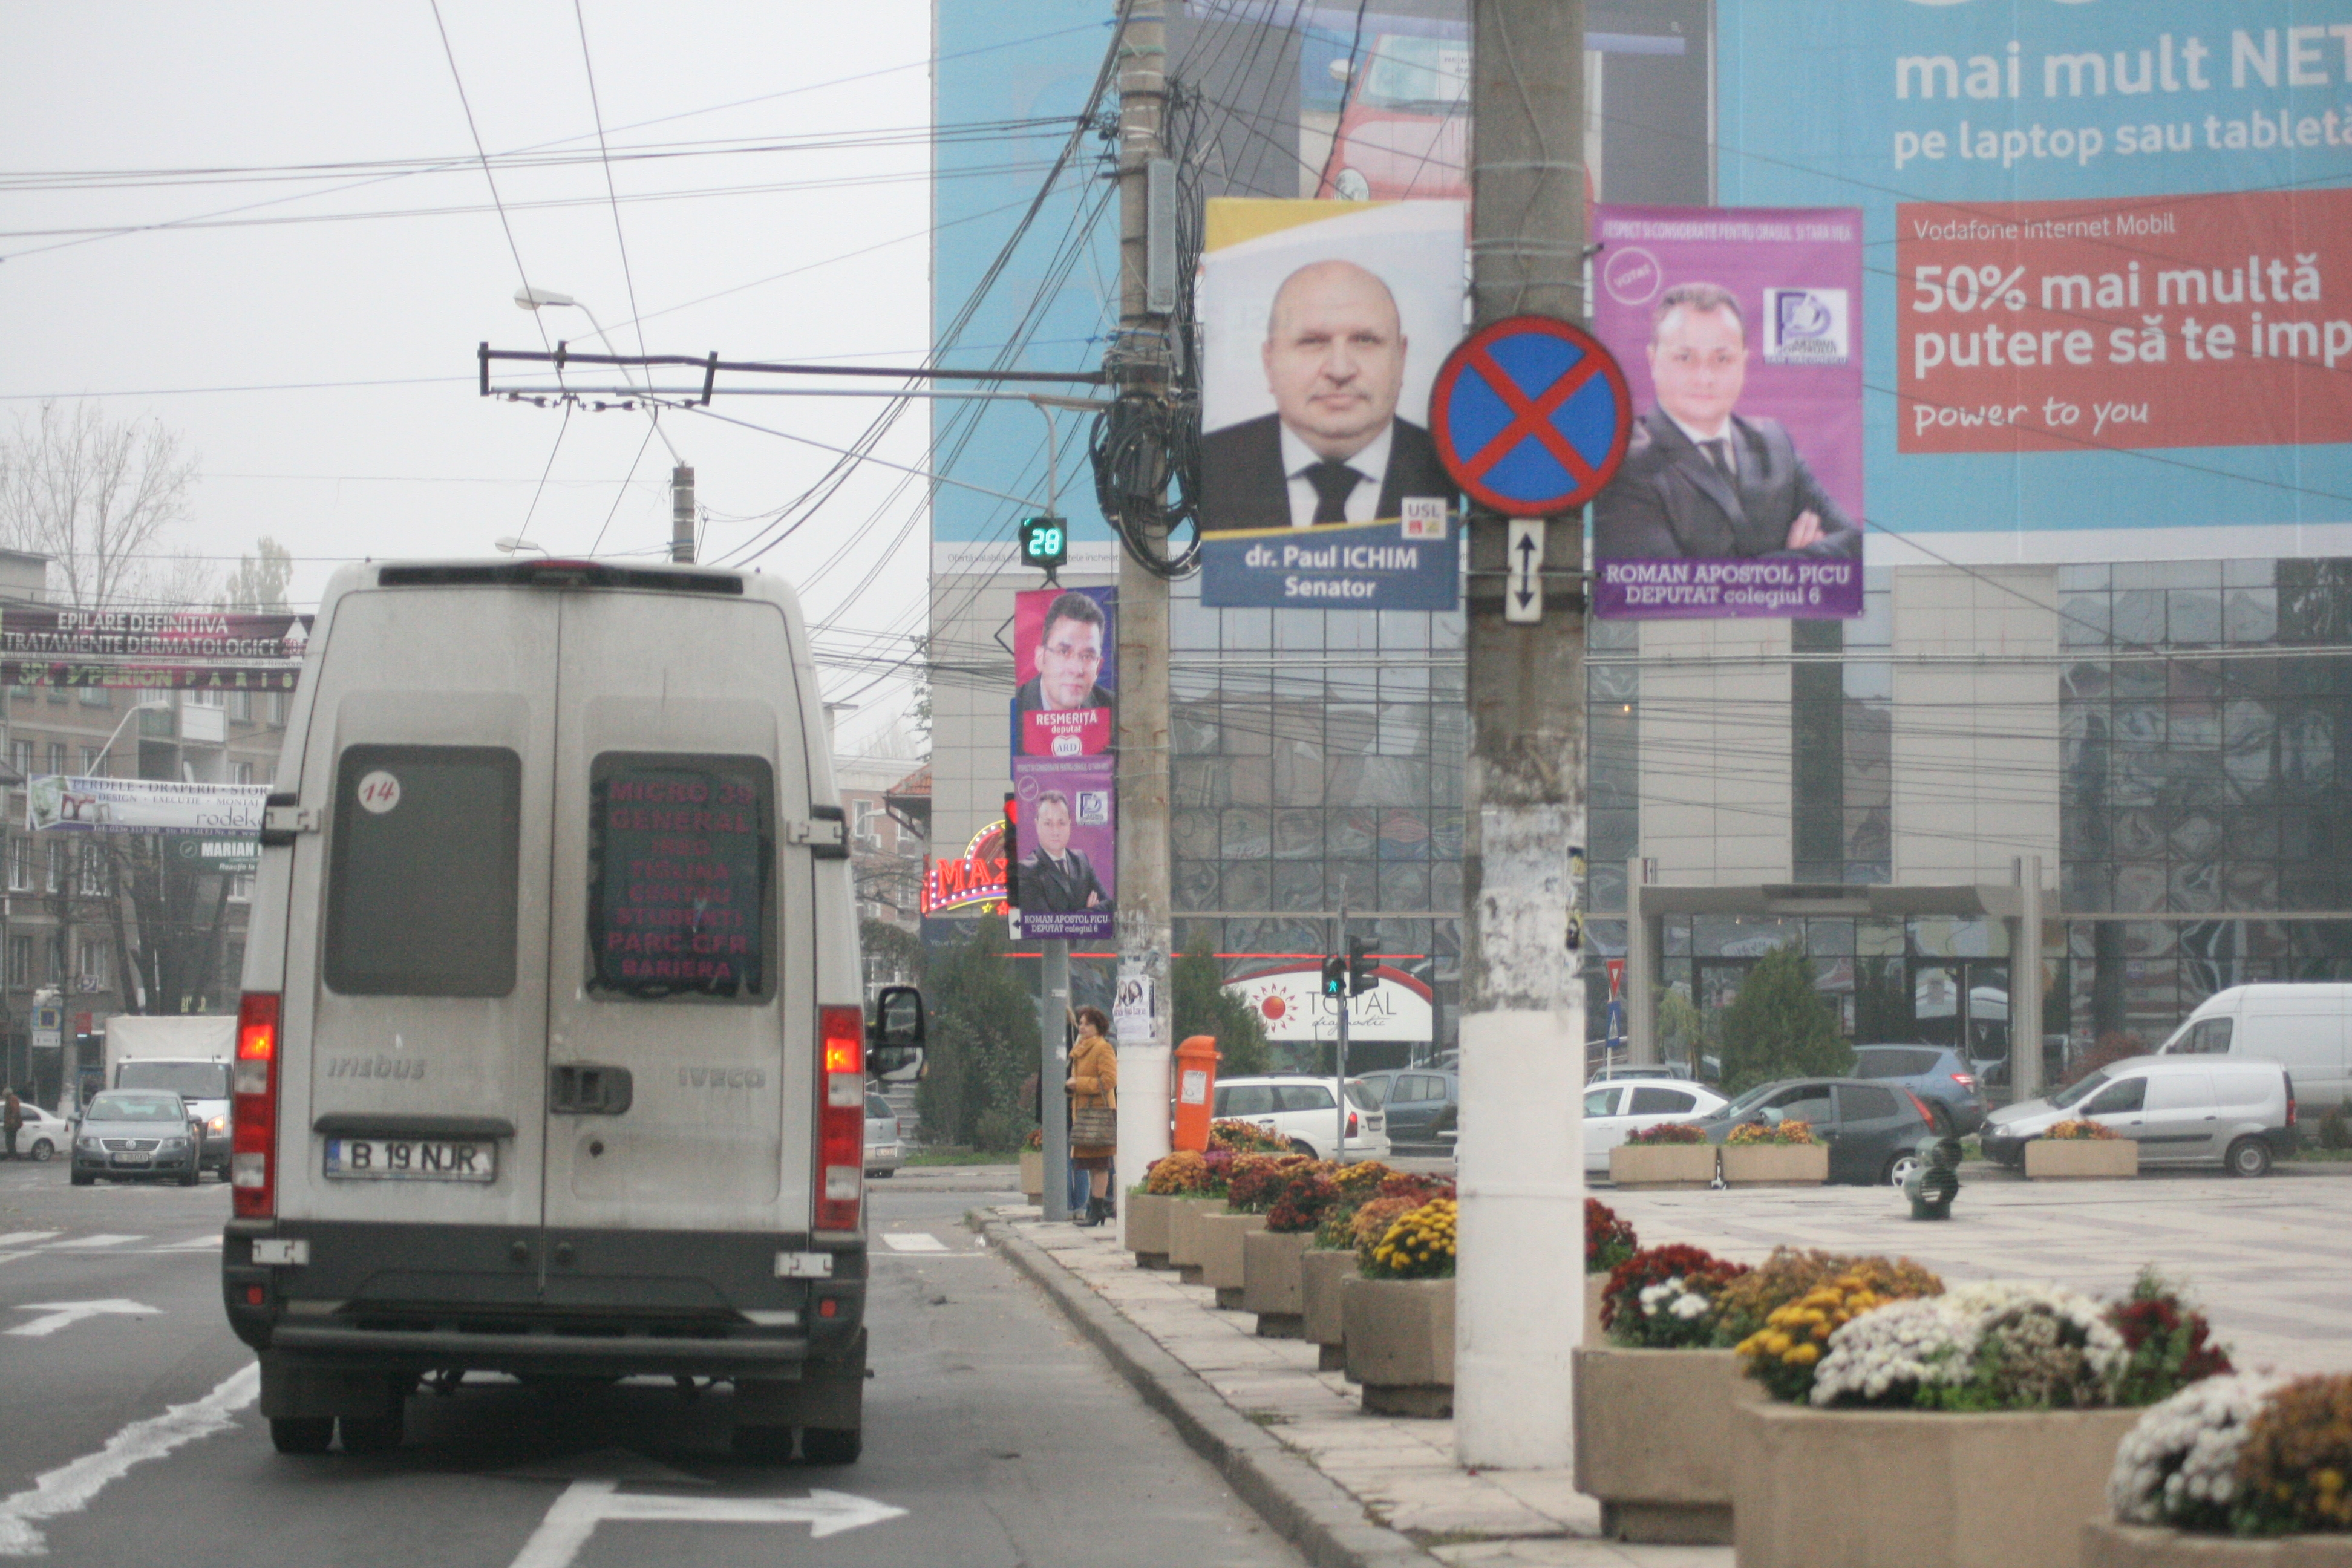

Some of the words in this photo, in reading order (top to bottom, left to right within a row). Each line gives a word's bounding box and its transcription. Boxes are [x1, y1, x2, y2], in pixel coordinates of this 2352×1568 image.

[1895, 39, 2020, 99] mai
[2043, 33, 2210, 98] mult
[1894, 130, 1947, 170] pe
[1959, 121, 2103, 169] laptop
[2115, 123, 2192, 155] sau
[1913, 218, 2019, 241] Vodafone
[2116, 212, 2176, 235] Mobil
[1912, 264, 2027, 312] 50%
[2041, 260, 2140, 310] mai
[2157, 252, 2321, 307] multă
[1914, 323, 2094, 379] putere
[2108, 313, 2167, 364] să
[2181, 317, 2236, 361] te
[1912, 402, 2028, 436] power
[2042, 396, 2080, 426] to
[2092, 402, 2149, 436] you
[1408, 503, 1437, 517] USL
[1029, 528, 1060, 555] 28
[1244, 544, 1278, 567] dr.
[1283, 544, 1336, 568] Paul
[1343, 546, 1418, 570] ICHIM
[1605, 564, 1689, 583] ROMAN
[1694, 564, 1794, 584] APOSTOL
[1798, 564, 1851, 584] PICU
[1284, 575, 1376, 598] Senator
[1625, 585, 1720, 604] DEPUTAT
[1723, 586, 1805, 608] colegiul
[1808, 586, 1821, 604] 6
[57, 612, 126, 632] EPILARE
[129, 613, 229, 635] DEFINITIVA
[4, 631, 124, 653] TRATAMENTE
[127, 635, 279, 656] DERMATOLOGICE
[1051, 724, 1082, 734] deputat
[1057, 743, 1077, 753] ARD
[73, 779, 135, 791] PERDELE
[149, 782, 215, 794] DRAPERII
[363, 782, 394, 802] 14
[610, 782, 710, 803] MICRO
[98, 794, 137, 802] DESIGN
[153, 796, 200, 805] EXECUTIE
[217, 797, 258, 807] MONTAJ
[610, 809, 753, 834] GENERAL
[201, 842, 255, 857] MARIAN
[629, 884, 732, 903] CENTRU
[1024, 915, 1053, 924] ROMAN
[1054, 915, 1089, 924] APOSTOL
[1090, 914, 1108, 924] PICU
[1031, 924, 1064, 933] DEPUTAT
[1065, 923, 1092, 935] colegiul
[1093, 924, 1099, 933] 6
[607, 931, 684, 953] PARC
[679, 1066, 766, 1088] IVECO
[351, 1142, 372, 1169] B
[384, 1142, 411, 1170] 19
[421, 1142, 476, 1171] NJR
